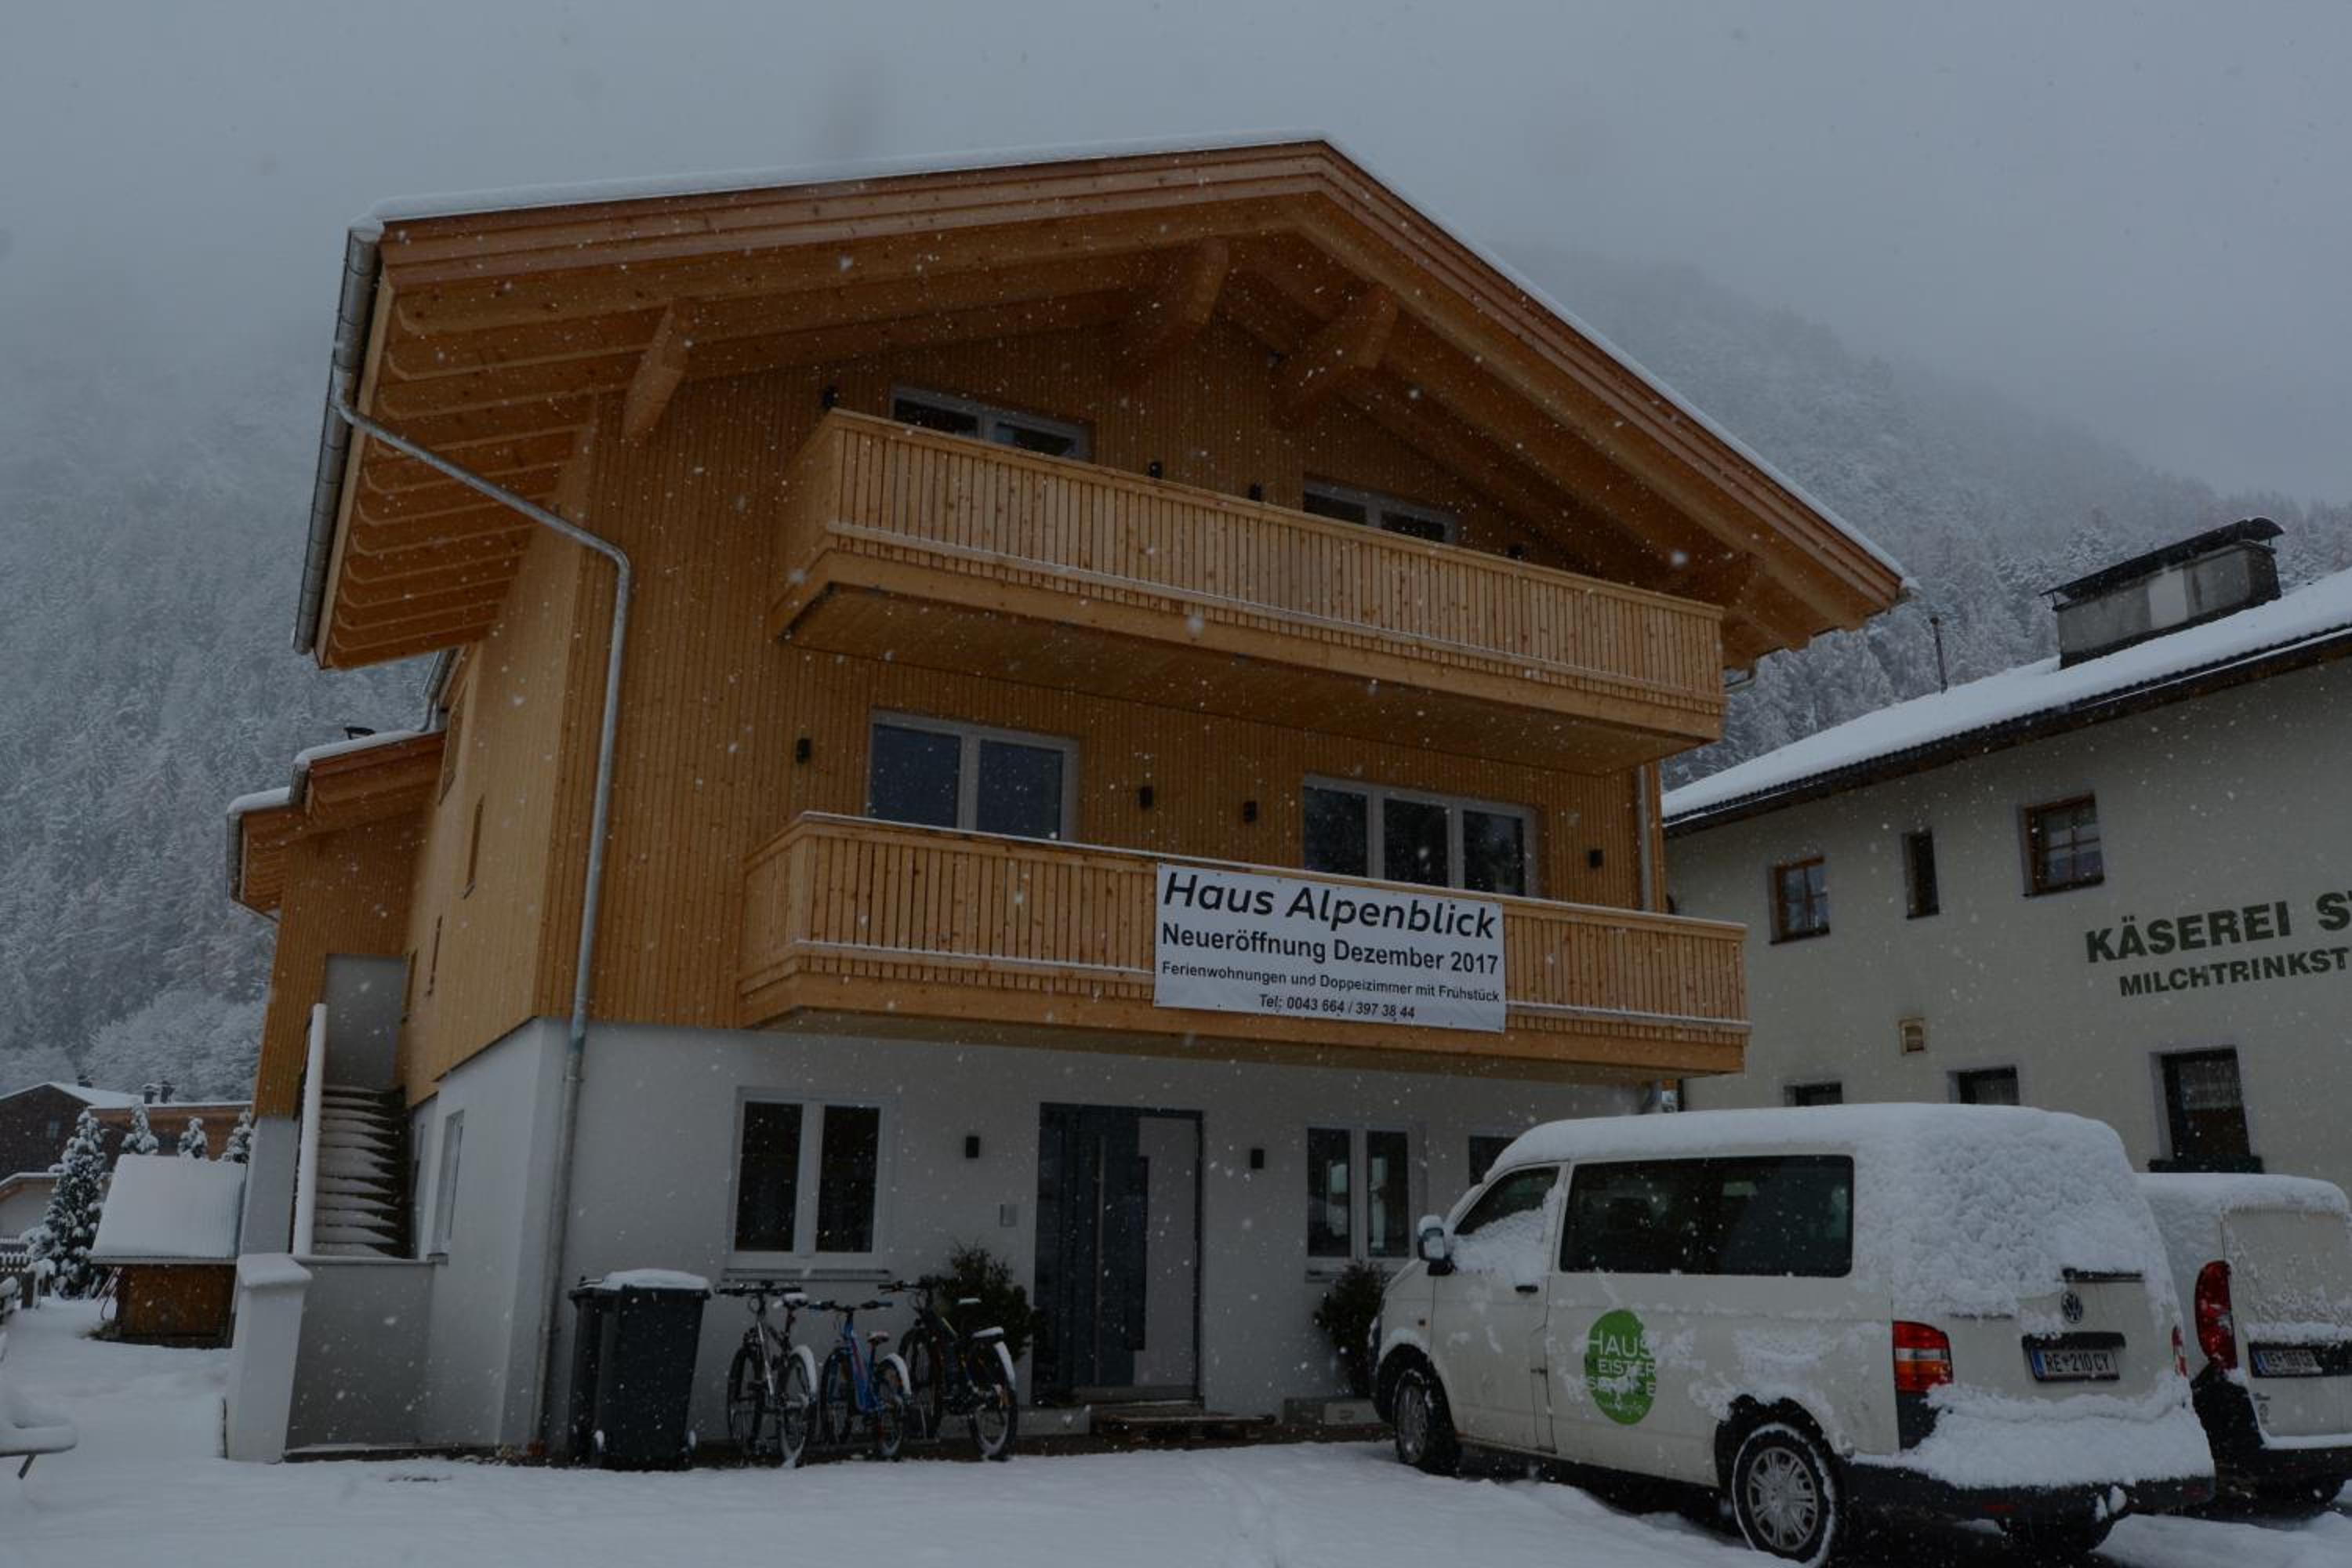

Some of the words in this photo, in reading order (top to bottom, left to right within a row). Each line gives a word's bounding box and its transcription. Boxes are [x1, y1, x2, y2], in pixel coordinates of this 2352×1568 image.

[1163, 871, 1274, 915] Haus
[1285, 887, 1496, 938] Alpenblick
[2085, 901, 2291, 963] KÄSEREI
[2316, 890, 2352, 931] S
[1163, 921, 1326, 964] Neueröffnung
[1334, 939, 1444, 969] Dezember
[1451, 951, 1498, 975] 2017
[1162, 961, 1287, 985] Ferienwohnungen
[1291, 975, 1316, 986] und
[1319, 975, 1413, 995] Doppelzimmer
[1416, 984, 1435, 996] mit
[1439, 985, 1500, 1002] Frühstück
[1287, 996, 1318, 1011] 0043
[1322, 999, 1345, 1013] 664
[1356, 1003, 1378, 1015] 397
[1381, 1005, 1397, 1016] 38
[1399, 1007, 1415, 1018] 44
[1585, 1330, 1654, 1359] HAUS
